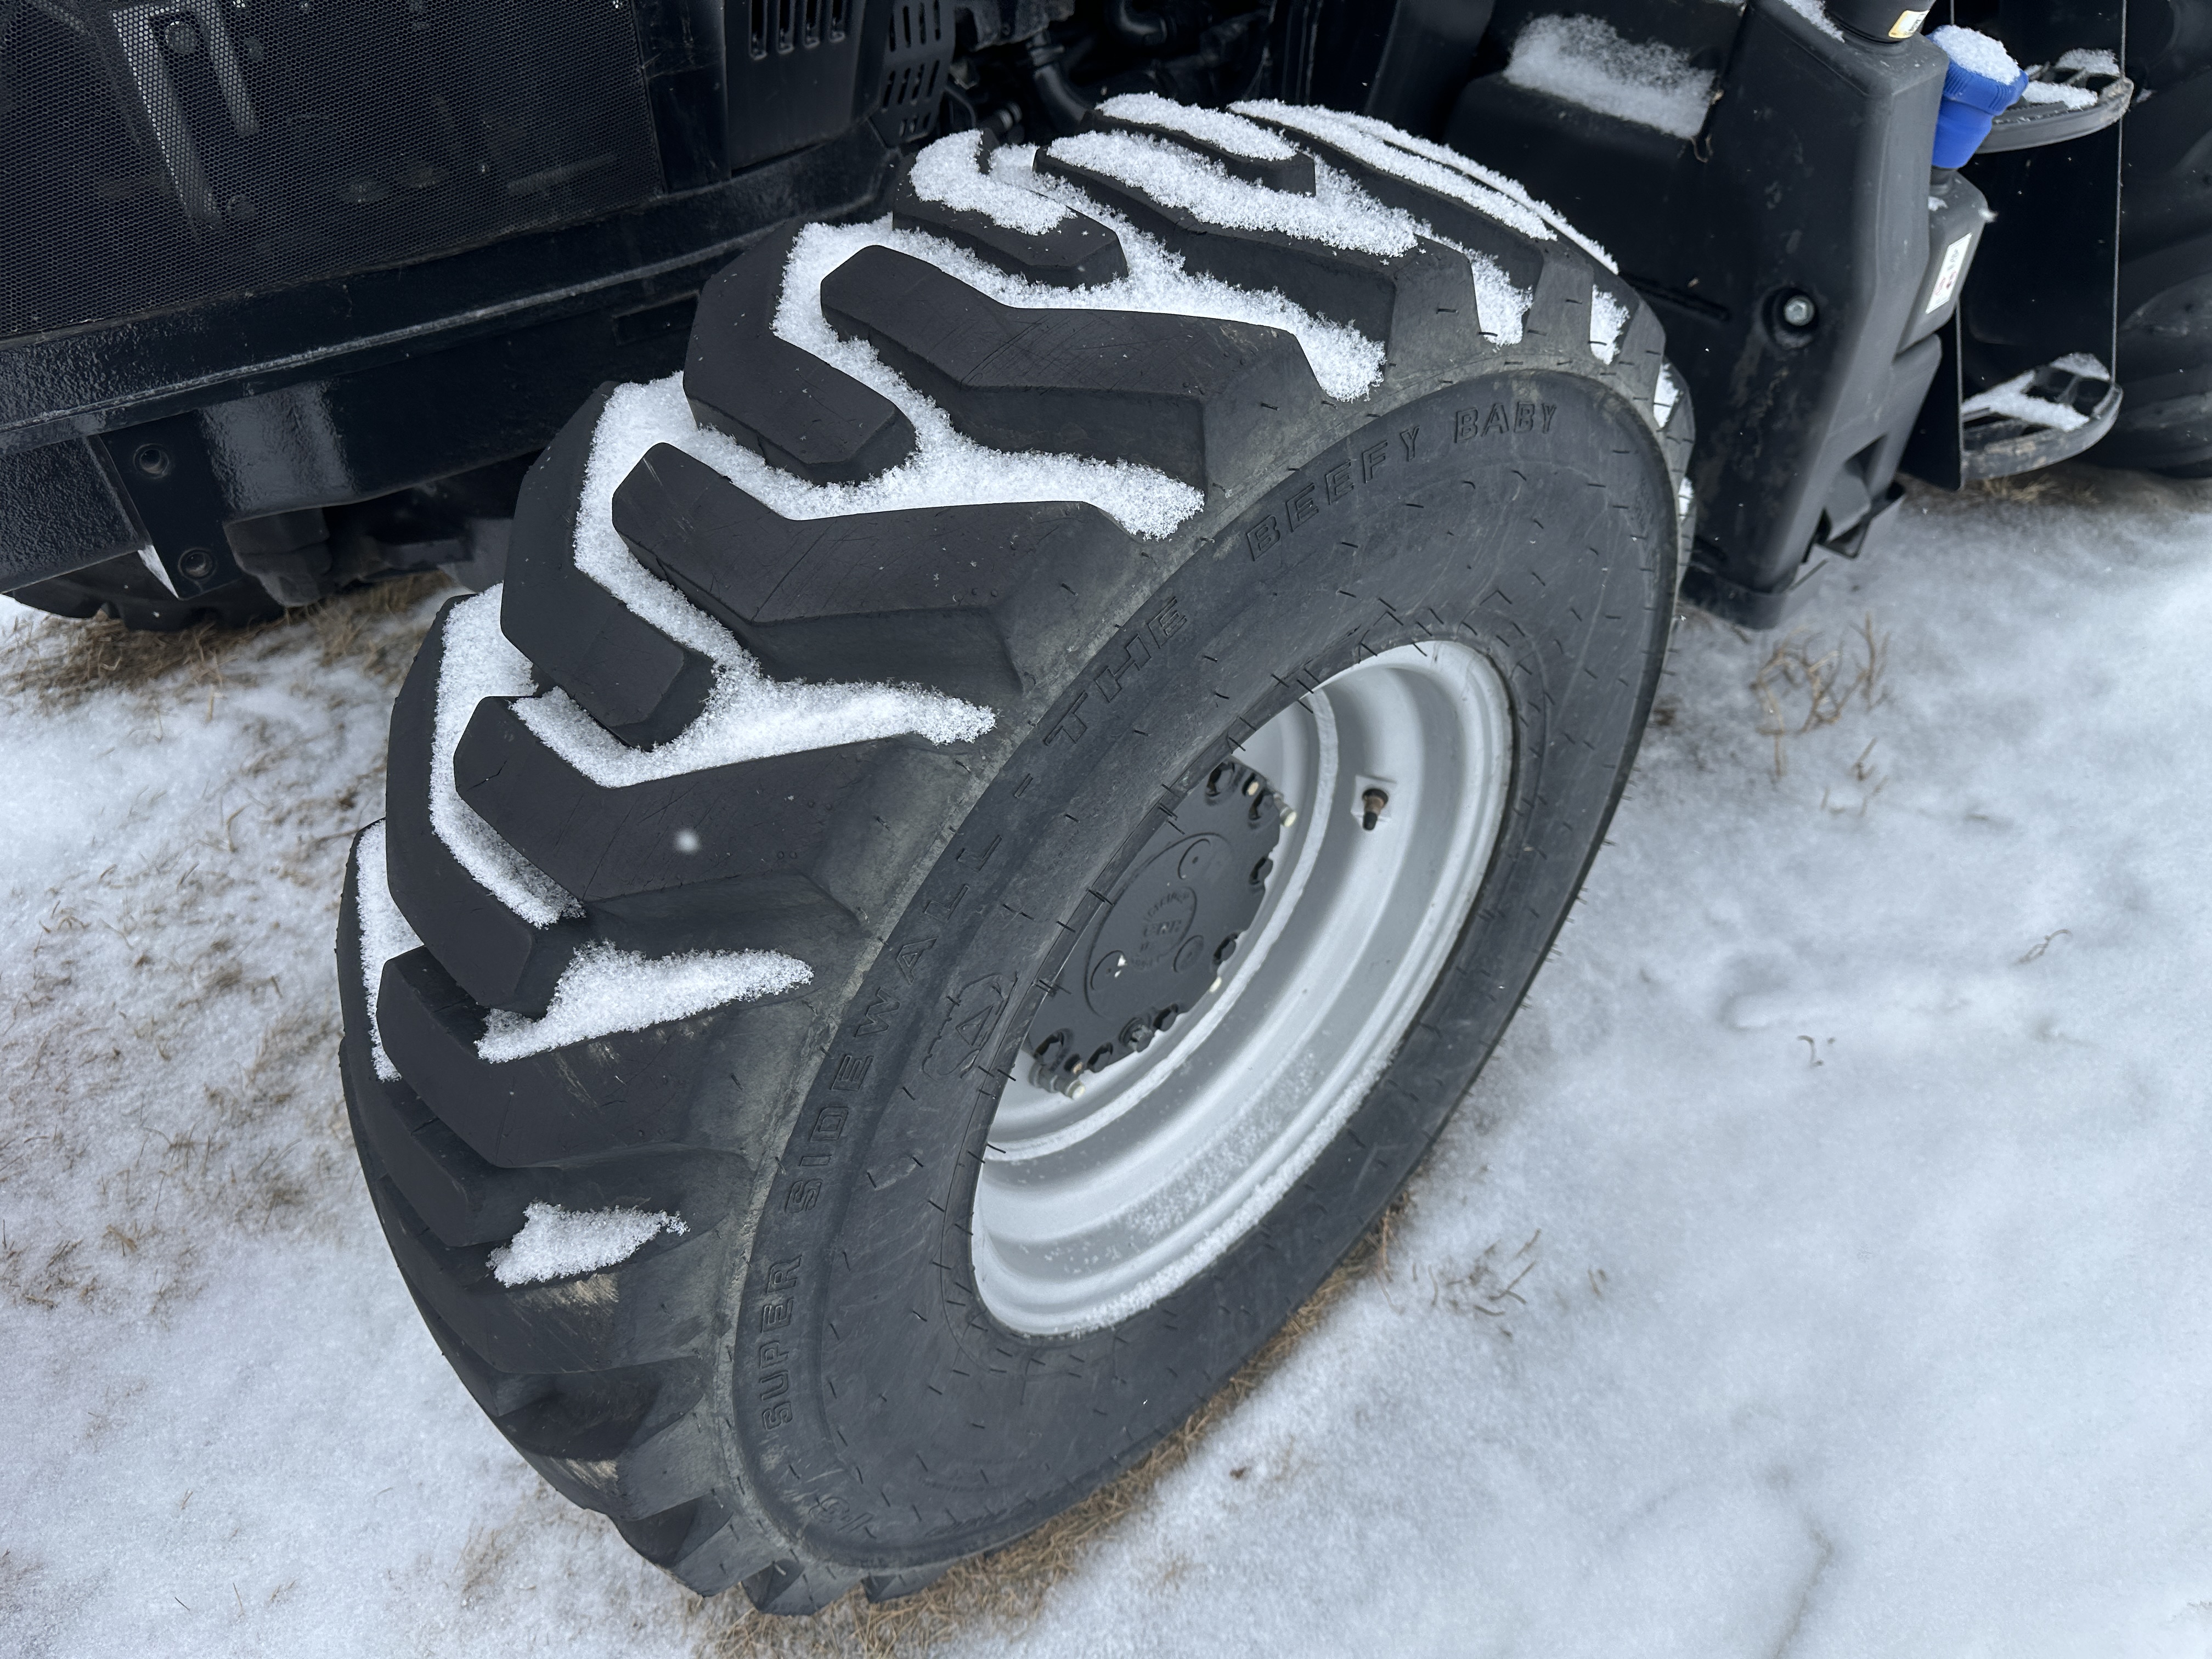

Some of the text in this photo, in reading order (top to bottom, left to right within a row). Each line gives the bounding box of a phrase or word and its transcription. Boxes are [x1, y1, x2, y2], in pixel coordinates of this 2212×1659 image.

[757, 1252, 803, 1431] SUPER
[785, 834, 1002, 1214] SIDEWALL
[1042, 596, 1188, 747] THE
[1246, 425, 1421, 562] BEEFY
[1453, 402, 1558, 445] BABY
